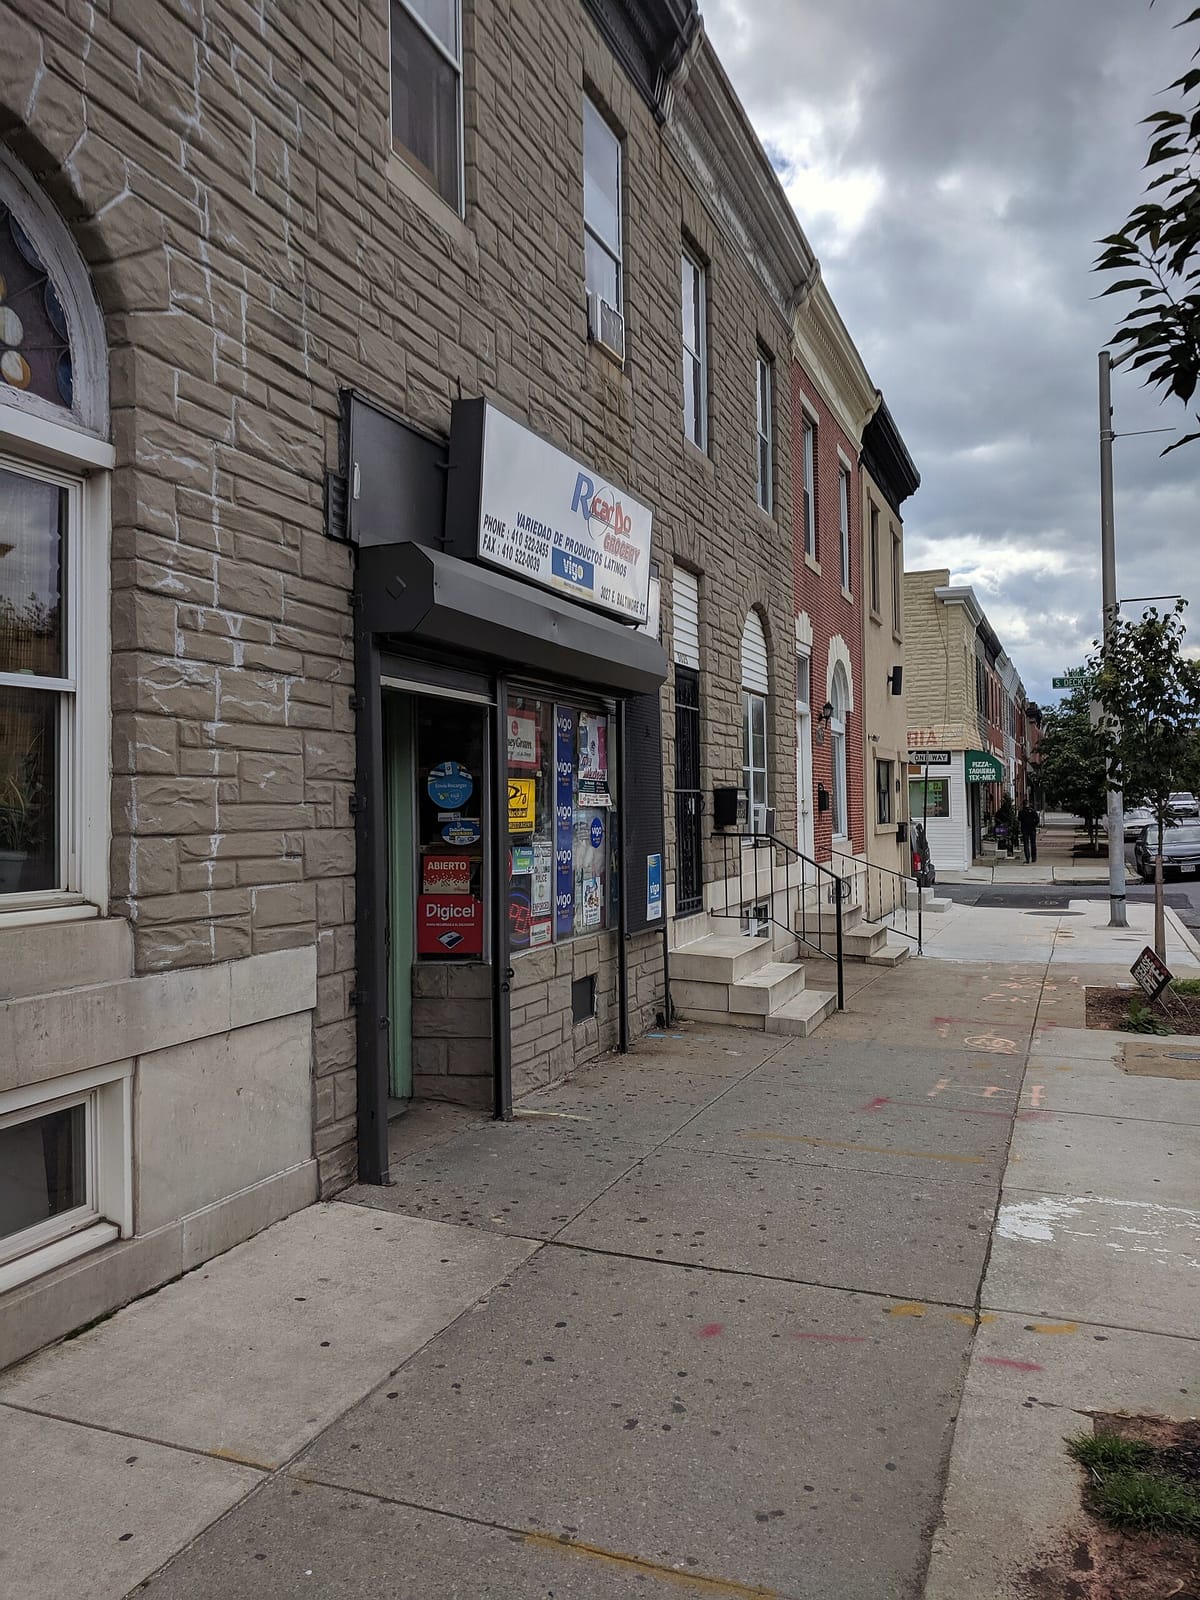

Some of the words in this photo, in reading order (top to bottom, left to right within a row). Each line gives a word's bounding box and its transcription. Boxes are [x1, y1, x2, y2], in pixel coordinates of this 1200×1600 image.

[483, 514, 506, 539] PHONE
[511, 529, 523, 546] 410
[524, 534, 549, 558] 522-2455
[517, 512, 552, 541] VARIEDAD
[553, 531, 564, 547] DE
[565, 537, 602, 566] PRODUCTOS
[604, 556, 627, 578] LATINOS
[482, 534, 496, 554] FAX
[501, 543, 514, 561] 410
[603, 532, 640, 566] GROCERY
[563, 555, 584, 582] vigo
[616, 592, 639, 612] BALTIMORE
[556, 714, 572, 732] vigo
[556, 758, 572, 776] vigo
[556, 802, 572, 820] vigo
[591, 825, 602, 837] vigo
[556, 848, 572, 864] vigo
[427, 861, 467, 870] ABIERTO
[556, 892, 572, 908] vigo
[425, 903, 475, 921] Digicel
